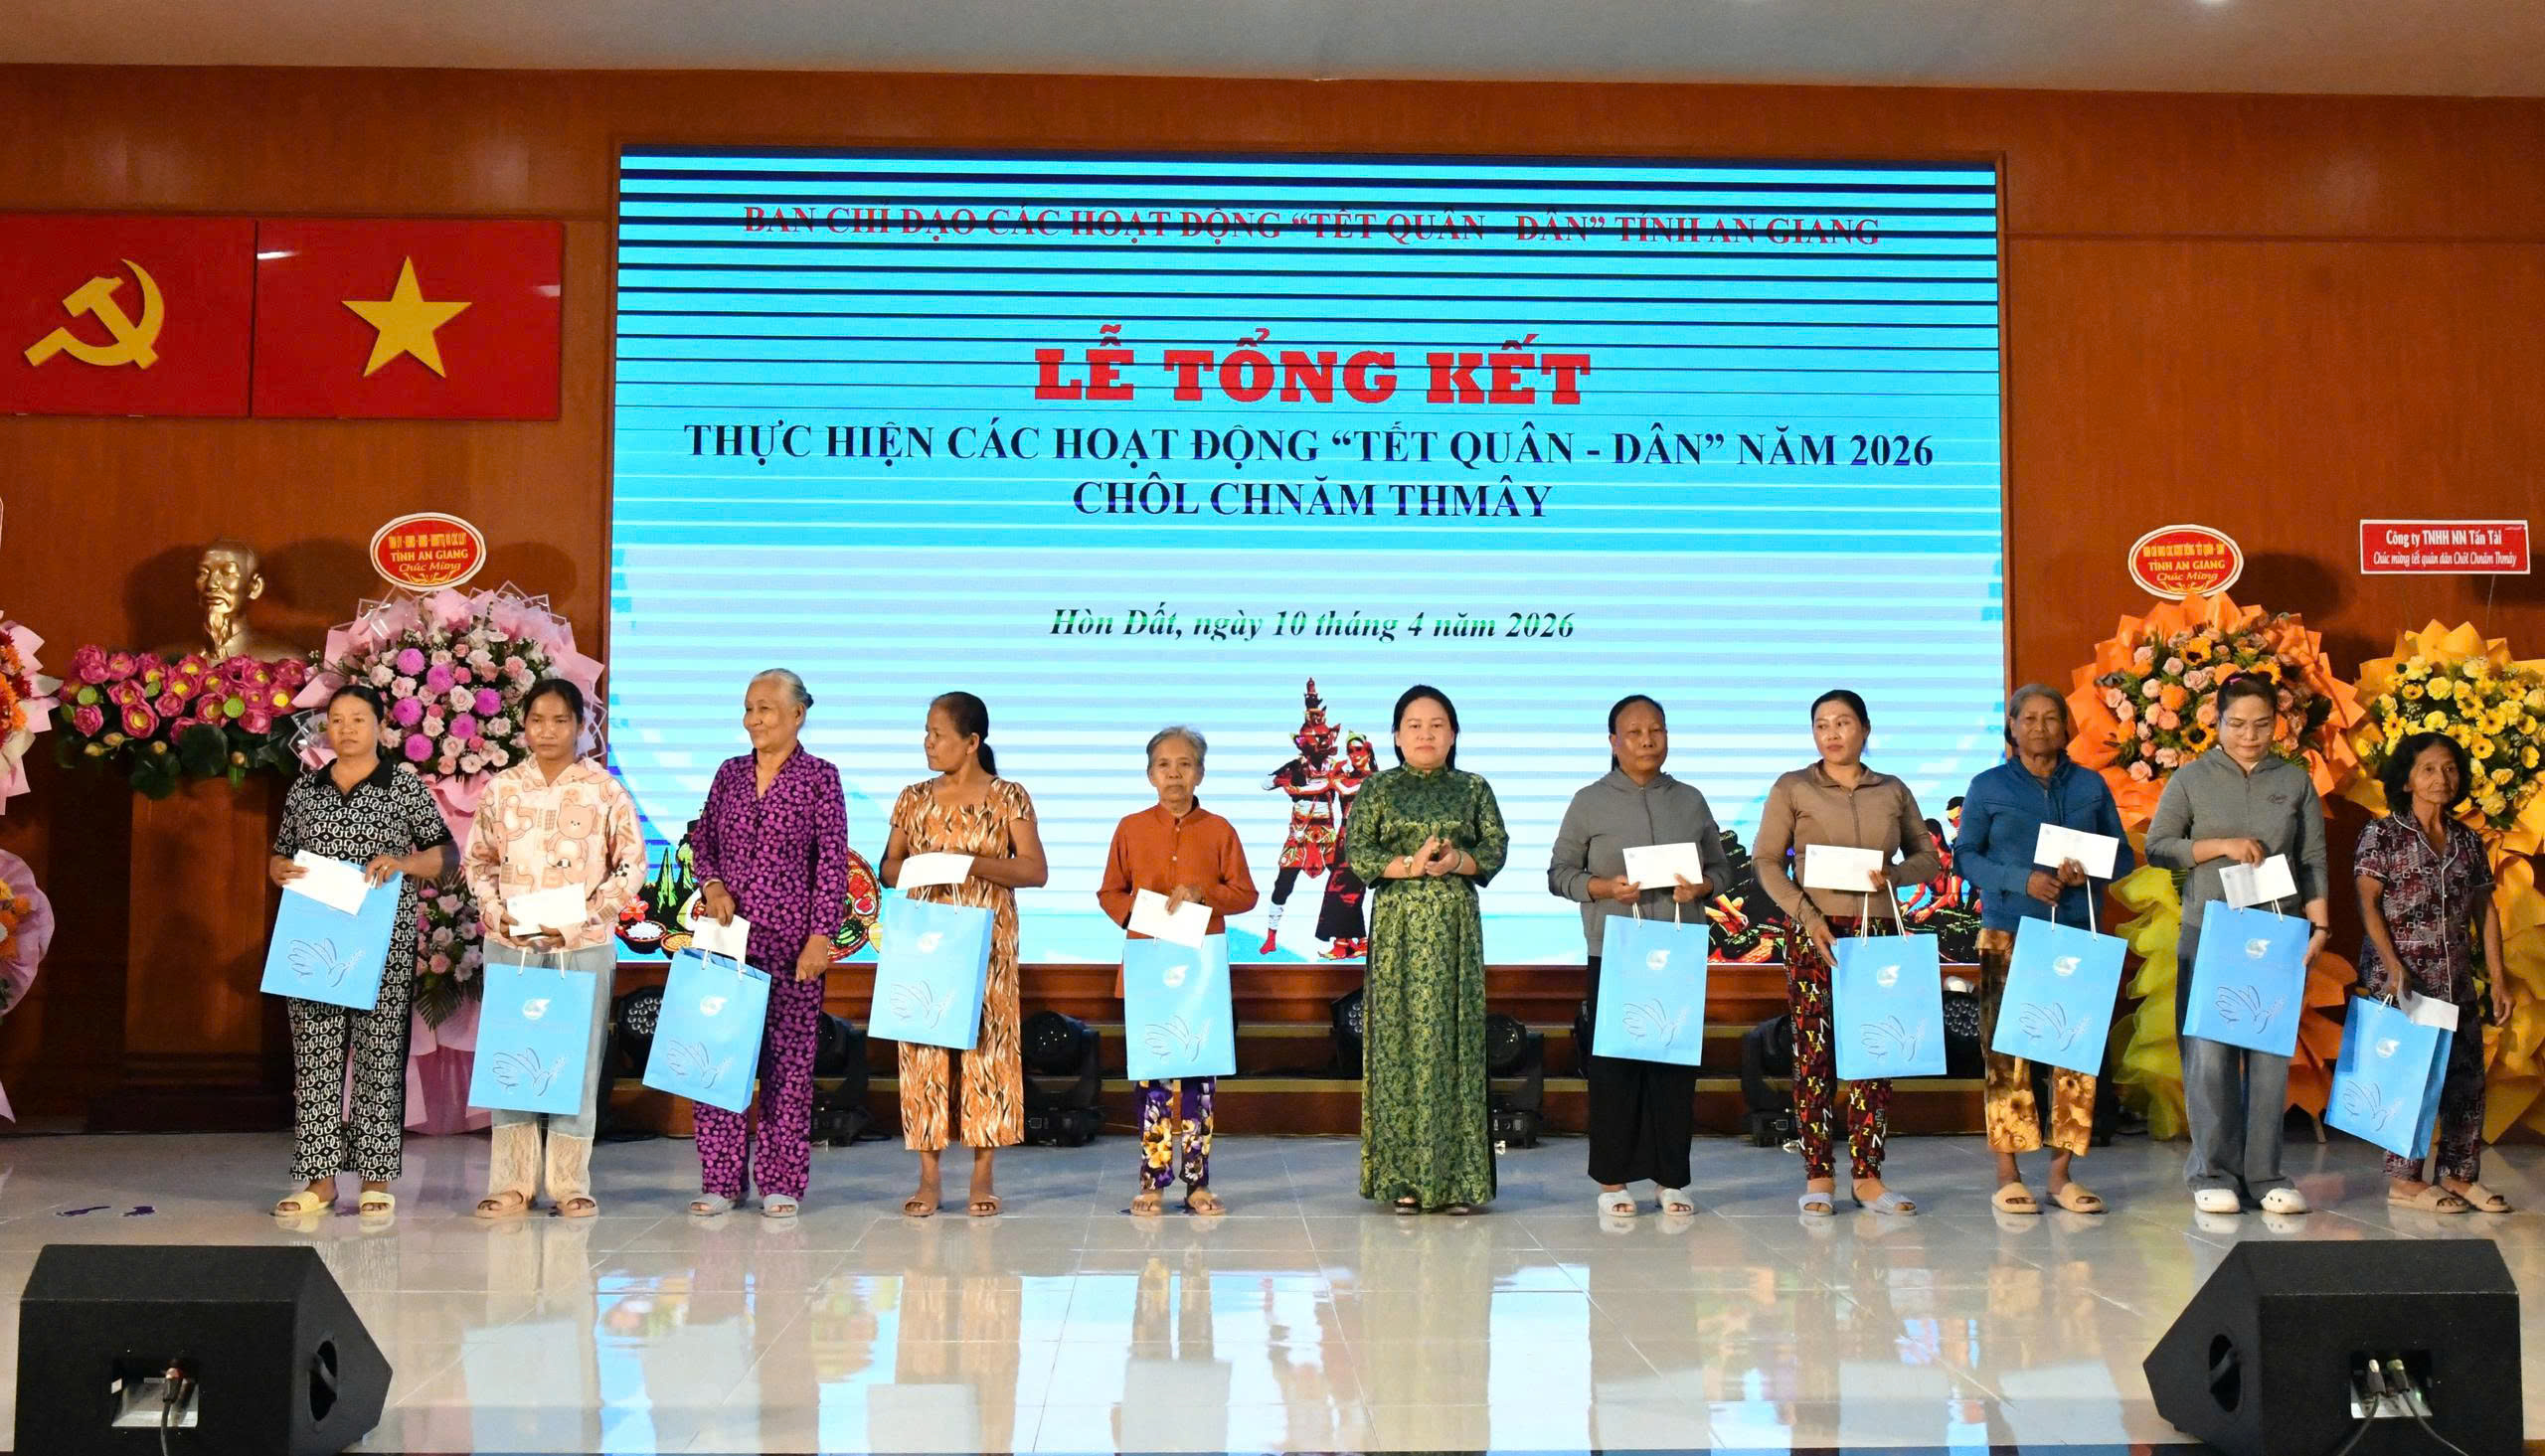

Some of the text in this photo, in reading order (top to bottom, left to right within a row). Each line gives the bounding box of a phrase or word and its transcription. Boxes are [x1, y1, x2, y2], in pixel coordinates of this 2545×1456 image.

[745, 207, 814, 233] BAN
[987, 202, 1060, 236] CÁC
[1072, 210, 1170, 243] HOẠT
[1387, 206, 1485, 244] QUÂN
[1709, 218, 1757, 243] AN
[1767, 218, 1879, 245] GIANG
[1035, 324, 1591, 404] LỄ TỔNG KẾT
[684, 418, 812, 466] THỰC
[827, 421, 933, 467] HIỆN
[947, 417, 1040, 460] CÁC
[1056, 427, 1178, 469] HOẠT
[1189, 423, 1318, 470] ĐỘNG
[1332, 421, 1438, 464] “TẾT
[1449, 421, 1575, 471] QUÂN
[1613, 422, 1725, 466] DÂN”
[1737, 425, 1835, 467] NĂM
[1850, 435, 1934, 468] 2026
[1073, 470, 1553, 518] CHÔL CHNĂM THMÂY
[418, 551, 433, 562] AN
[435, 549, 469, 560] GIANG
[2386, 529, 2410, 548] Công
[2411, 532, 2421, 548] ty
[2422, 530, 2450, 546] TNHH
[2452, 530, 2467, 546] NN
[2175, 561, 2190, 570] AN
[2192, 560, 2226, 570] GIANG
[1050, 608, 1113, 635] Hòn
[1193, 609, 1263, 642] ngày
[1272, 610, 1307, 638] 10
[1314, 610, 1399, 644] tháng
[1407, 611, 1423, 638] 4
[1433, 611, 1496, 638] năm
[1505, 611, 1575, 639] 2026
